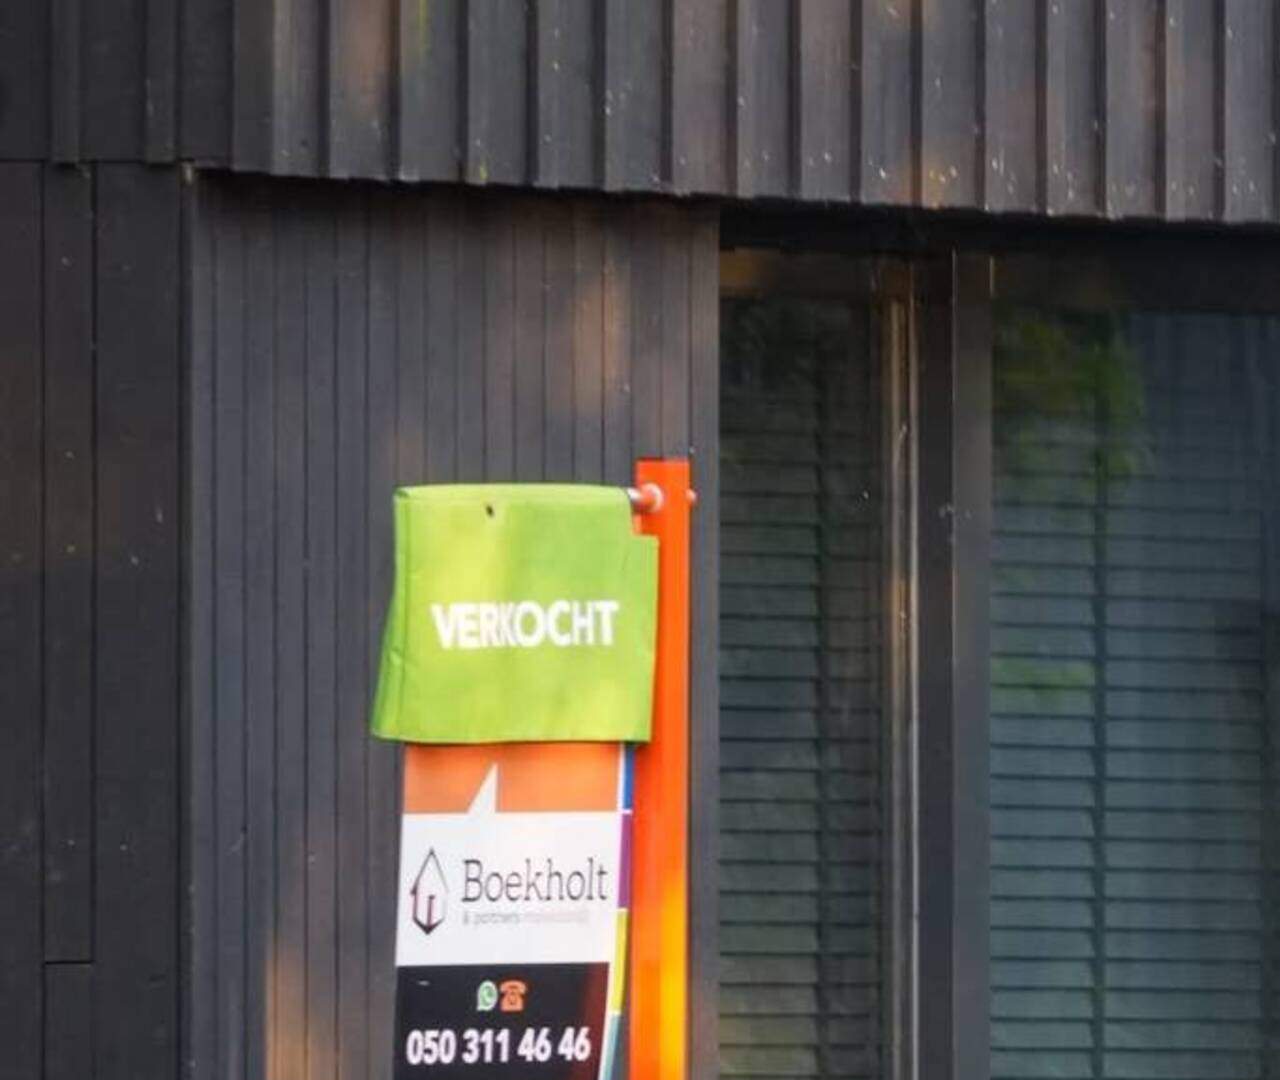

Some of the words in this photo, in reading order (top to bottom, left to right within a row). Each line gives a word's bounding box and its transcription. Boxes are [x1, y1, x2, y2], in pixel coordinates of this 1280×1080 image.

[430, 599, 619, 649] VERKOCHT
[460, 856, 609, 903] Boekholt
[406, 1029, 457, 1065] 050
[461, 1028, 510, 1064] 311
[517, 1026, 552, 1062] 46
[558, 1026, 592, 1061] 46
